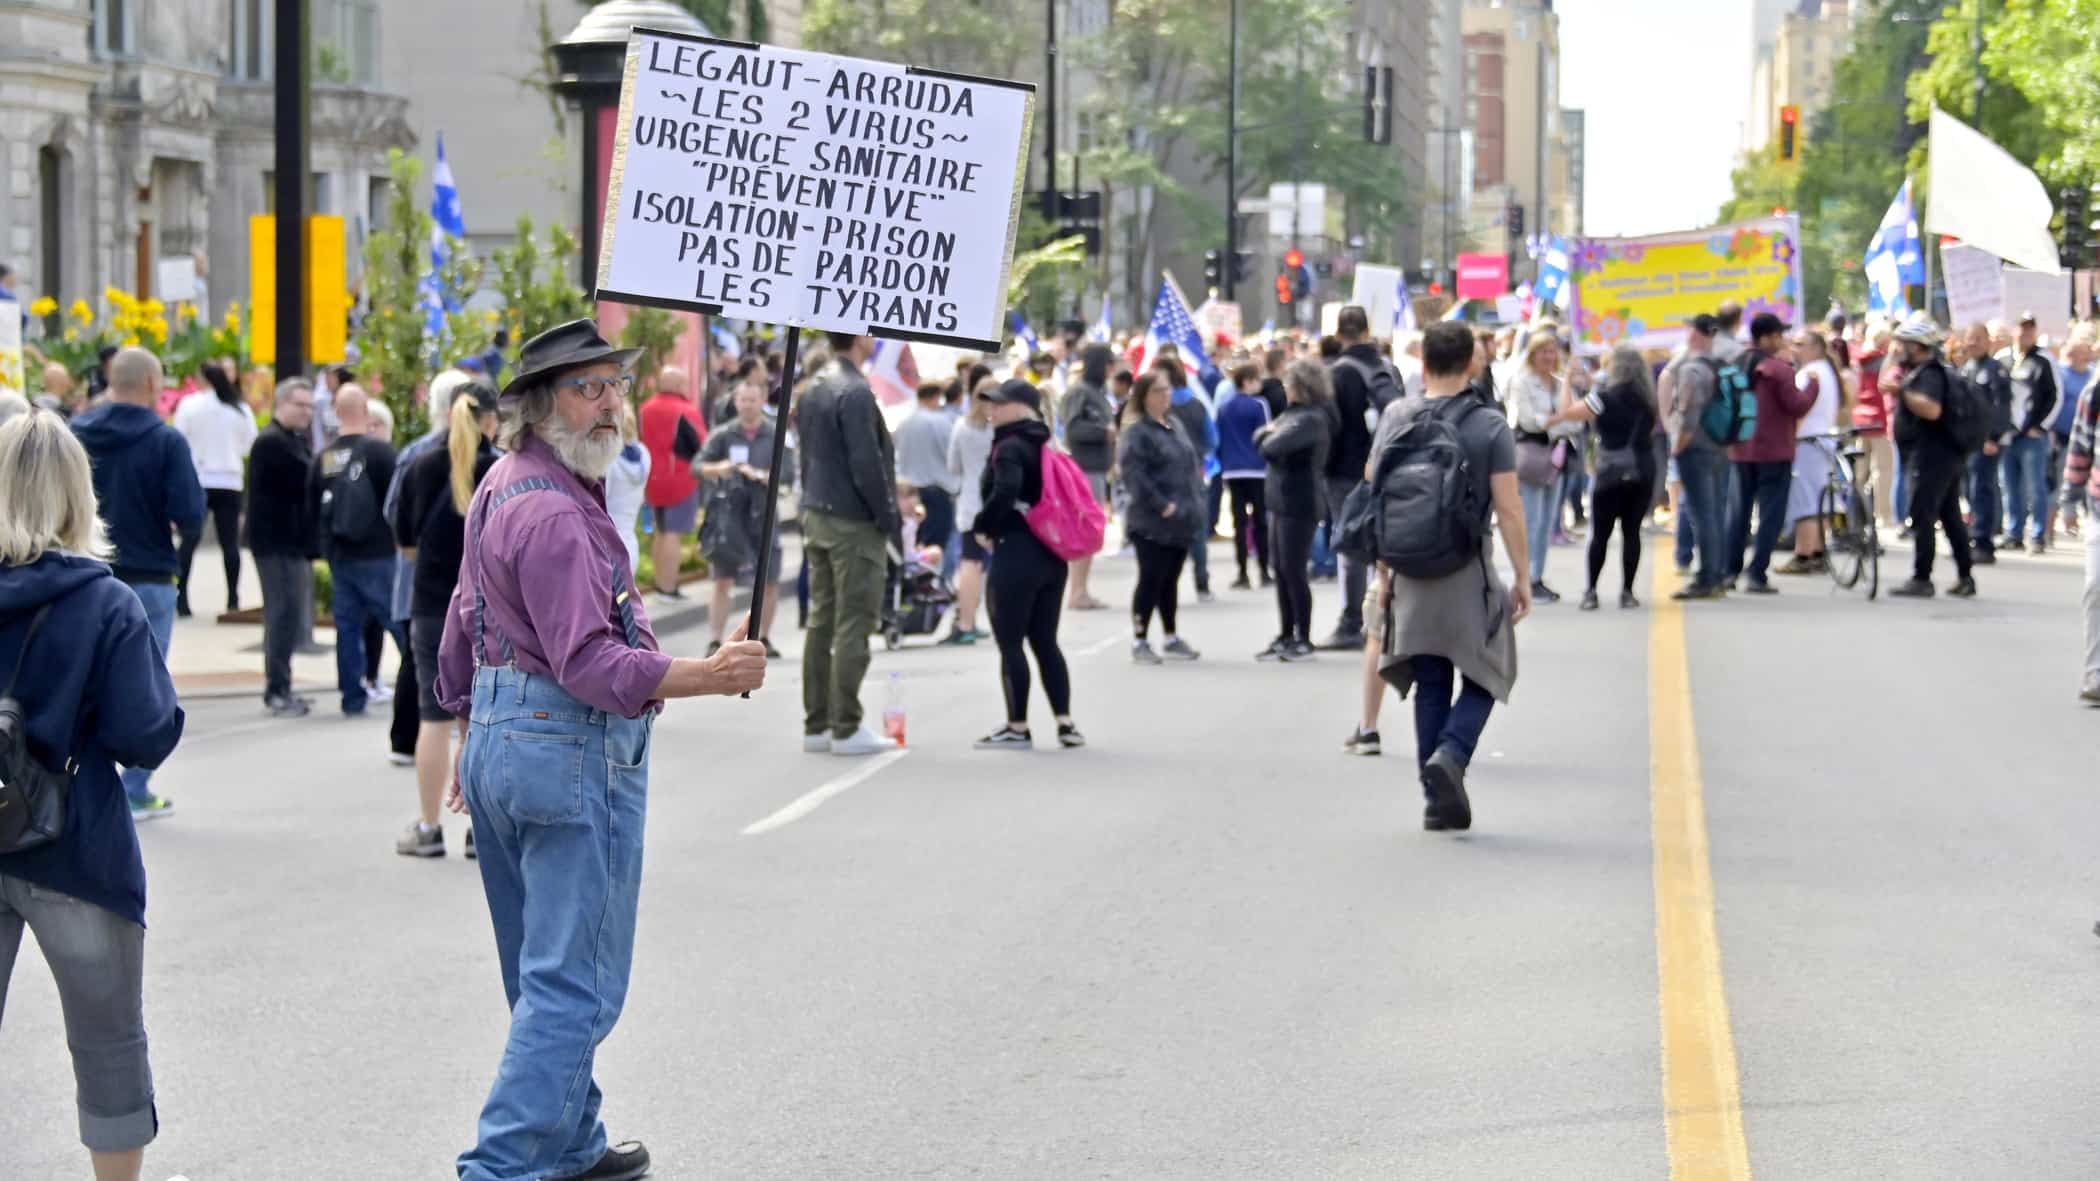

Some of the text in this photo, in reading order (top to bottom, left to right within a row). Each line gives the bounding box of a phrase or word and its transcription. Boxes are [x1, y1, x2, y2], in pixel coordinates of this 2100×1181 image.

[648, 41, 974, 118] LEGAUT-ARRUDA
[786, 100, 810, 131] 2
[635, 115, 983, 193] URGENCE SANITAIRE
[632, 189, 956, 263] ISOLATION-PRISON
[678, 231, 951, 297] PAS DE PARDON
[695, 269, 958, 332] LES TYRANS
